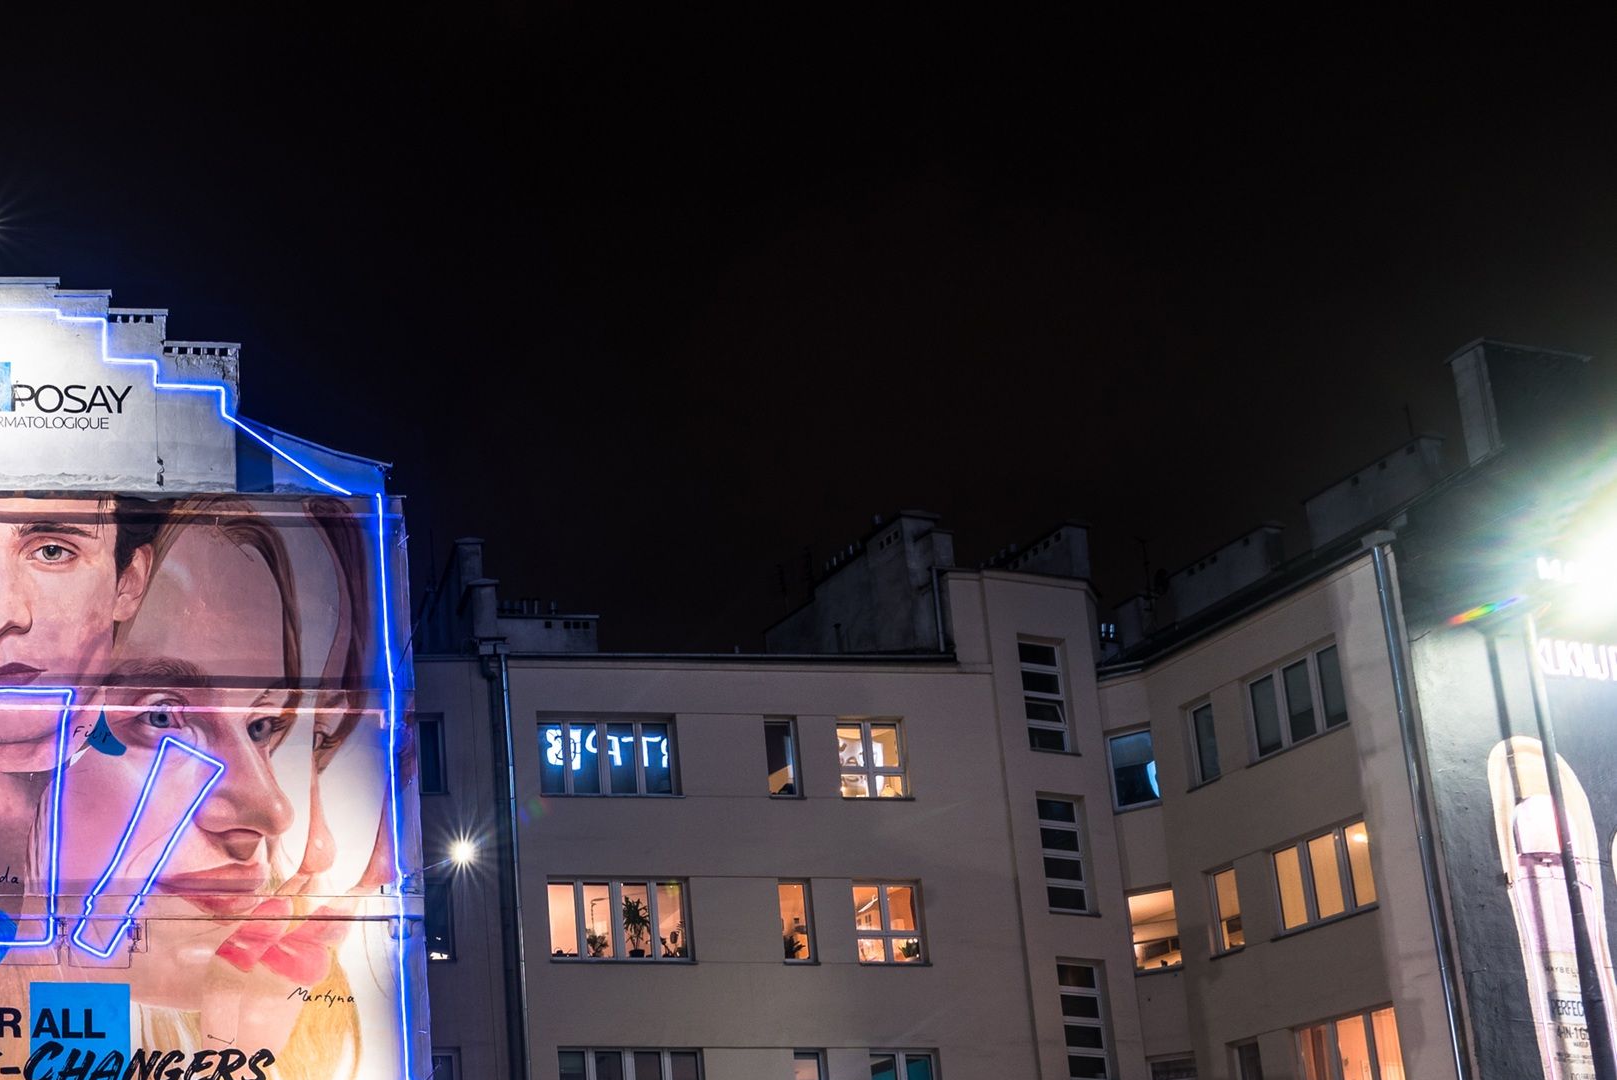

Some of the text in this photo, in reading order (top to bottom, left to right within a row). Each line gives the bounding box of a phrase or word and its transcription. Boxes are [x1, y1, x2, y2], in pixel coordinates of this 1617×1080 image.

[73, 724, 112, 743] Filip
[287, 987, 355, 1008] Martyna
[31, 1008, 106, 1040] ALL
